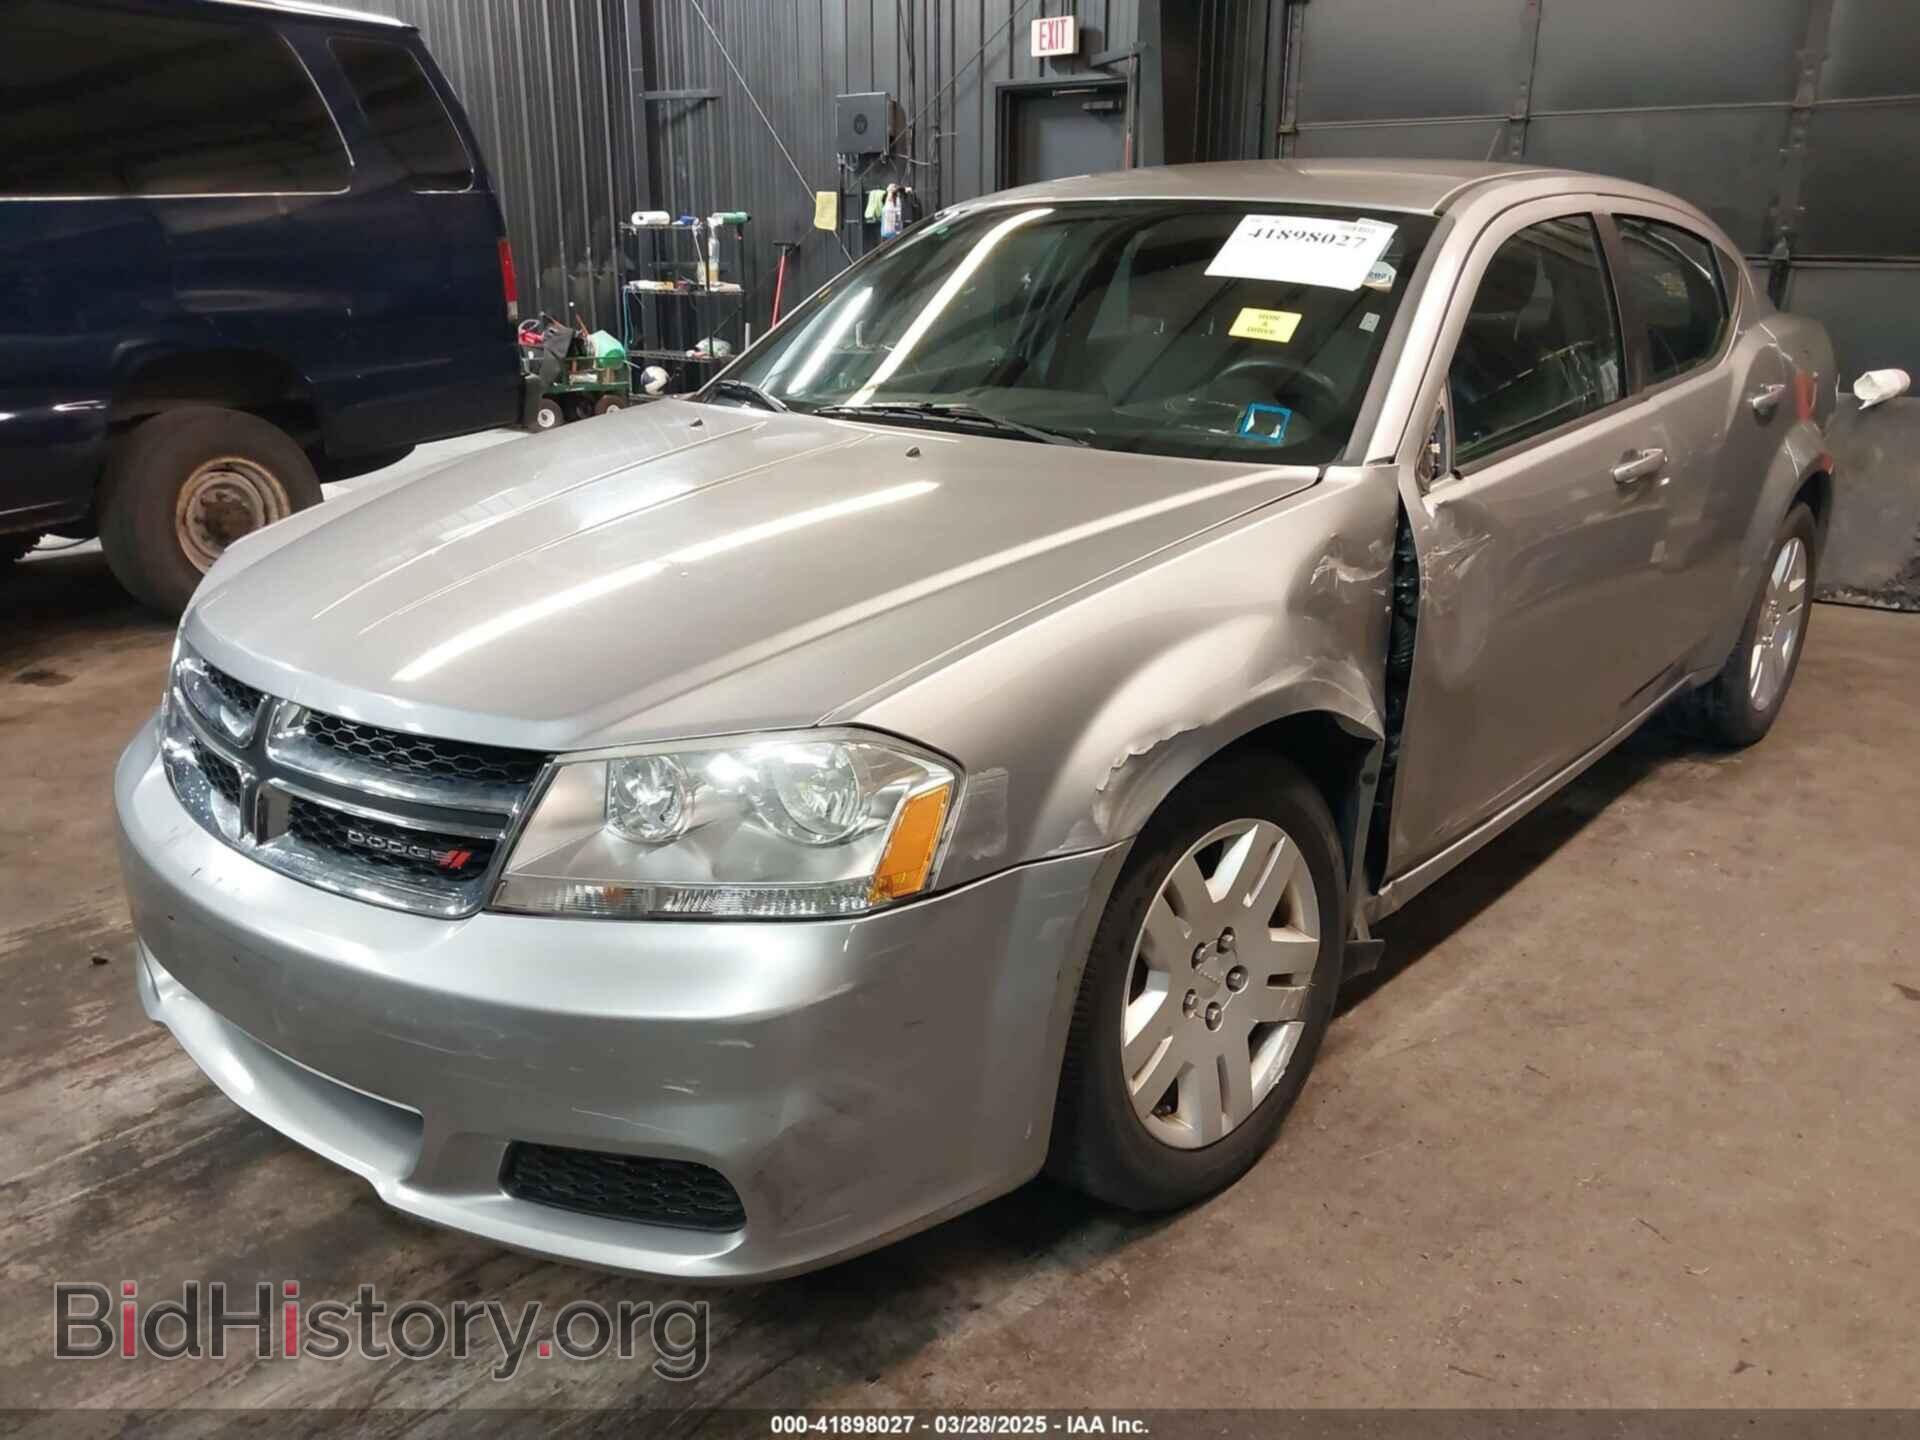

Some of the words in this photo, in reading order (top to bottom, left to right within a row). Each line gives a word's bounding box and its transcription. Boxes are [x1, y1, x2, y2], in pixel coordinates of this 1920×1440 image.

[1039, 19, 1067, 50] EXIT
[1248, 227, 1367, 249] 41898027
[347, 829, 447, 863] DODGE
